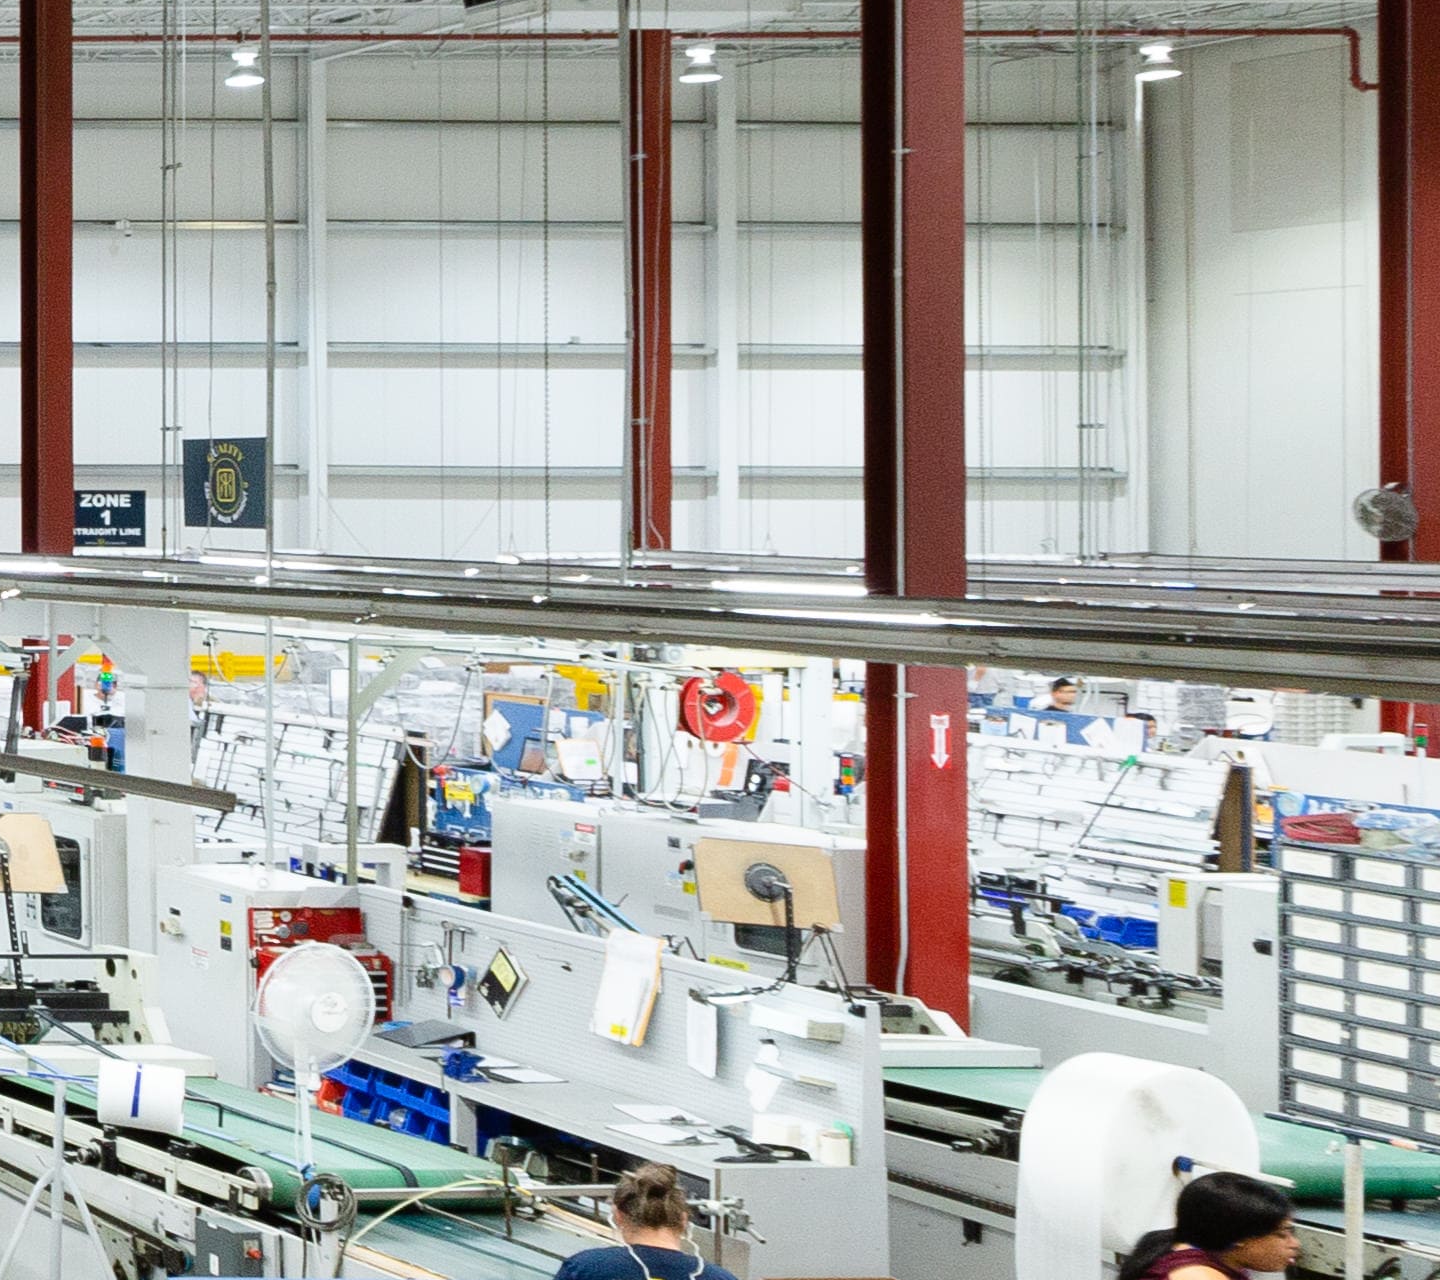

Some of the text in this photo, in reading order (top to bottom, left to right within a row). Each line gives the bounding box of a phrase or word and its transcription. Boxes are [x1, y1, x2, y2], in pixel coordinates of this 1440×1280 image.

[80, 493, 132, 508] ZONE
[100, 509, 111, 526] 1
[119, 527, 142, 536] LINE
